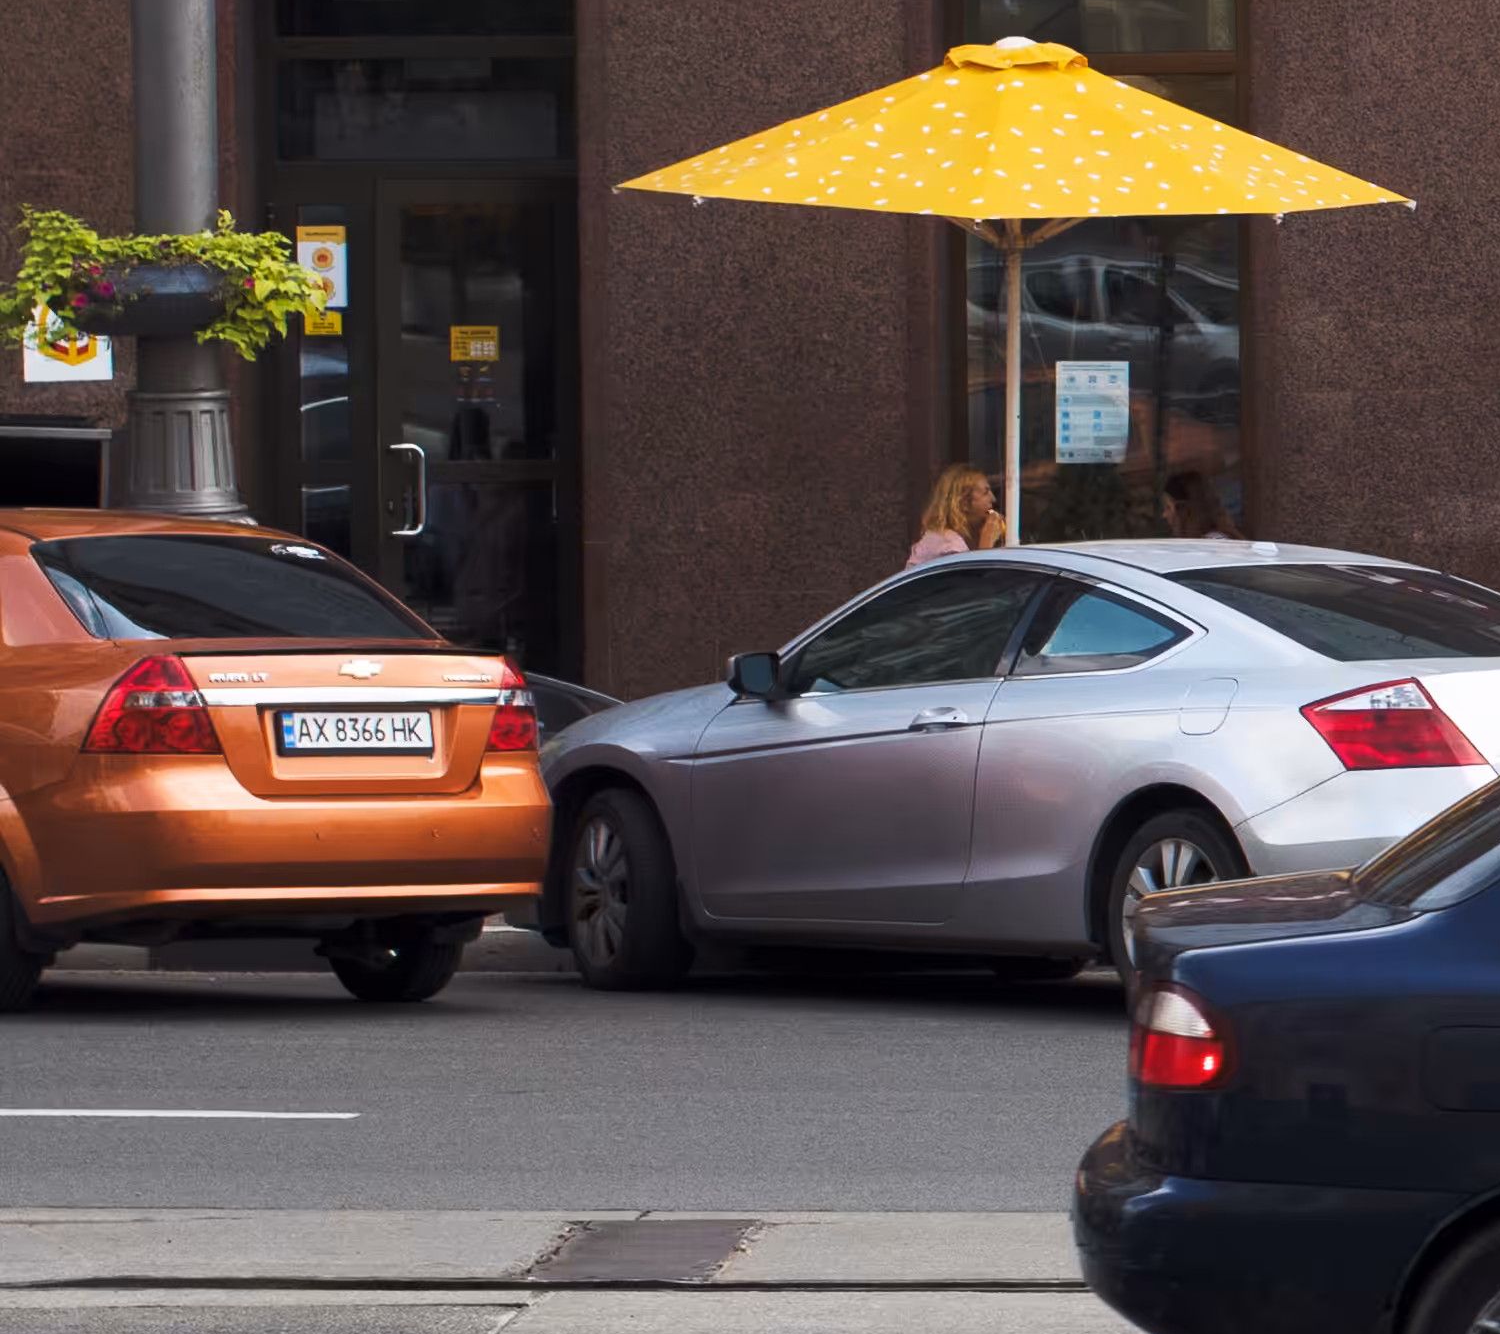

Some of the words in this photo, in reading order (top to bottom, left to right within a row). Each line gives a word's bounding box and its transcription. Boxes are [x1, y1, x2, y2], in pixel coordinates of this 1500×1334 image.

[298, 717, 330, 743] AX
[335, 717, 386, 743] 8366
[391, 716, 424, 742] HK
